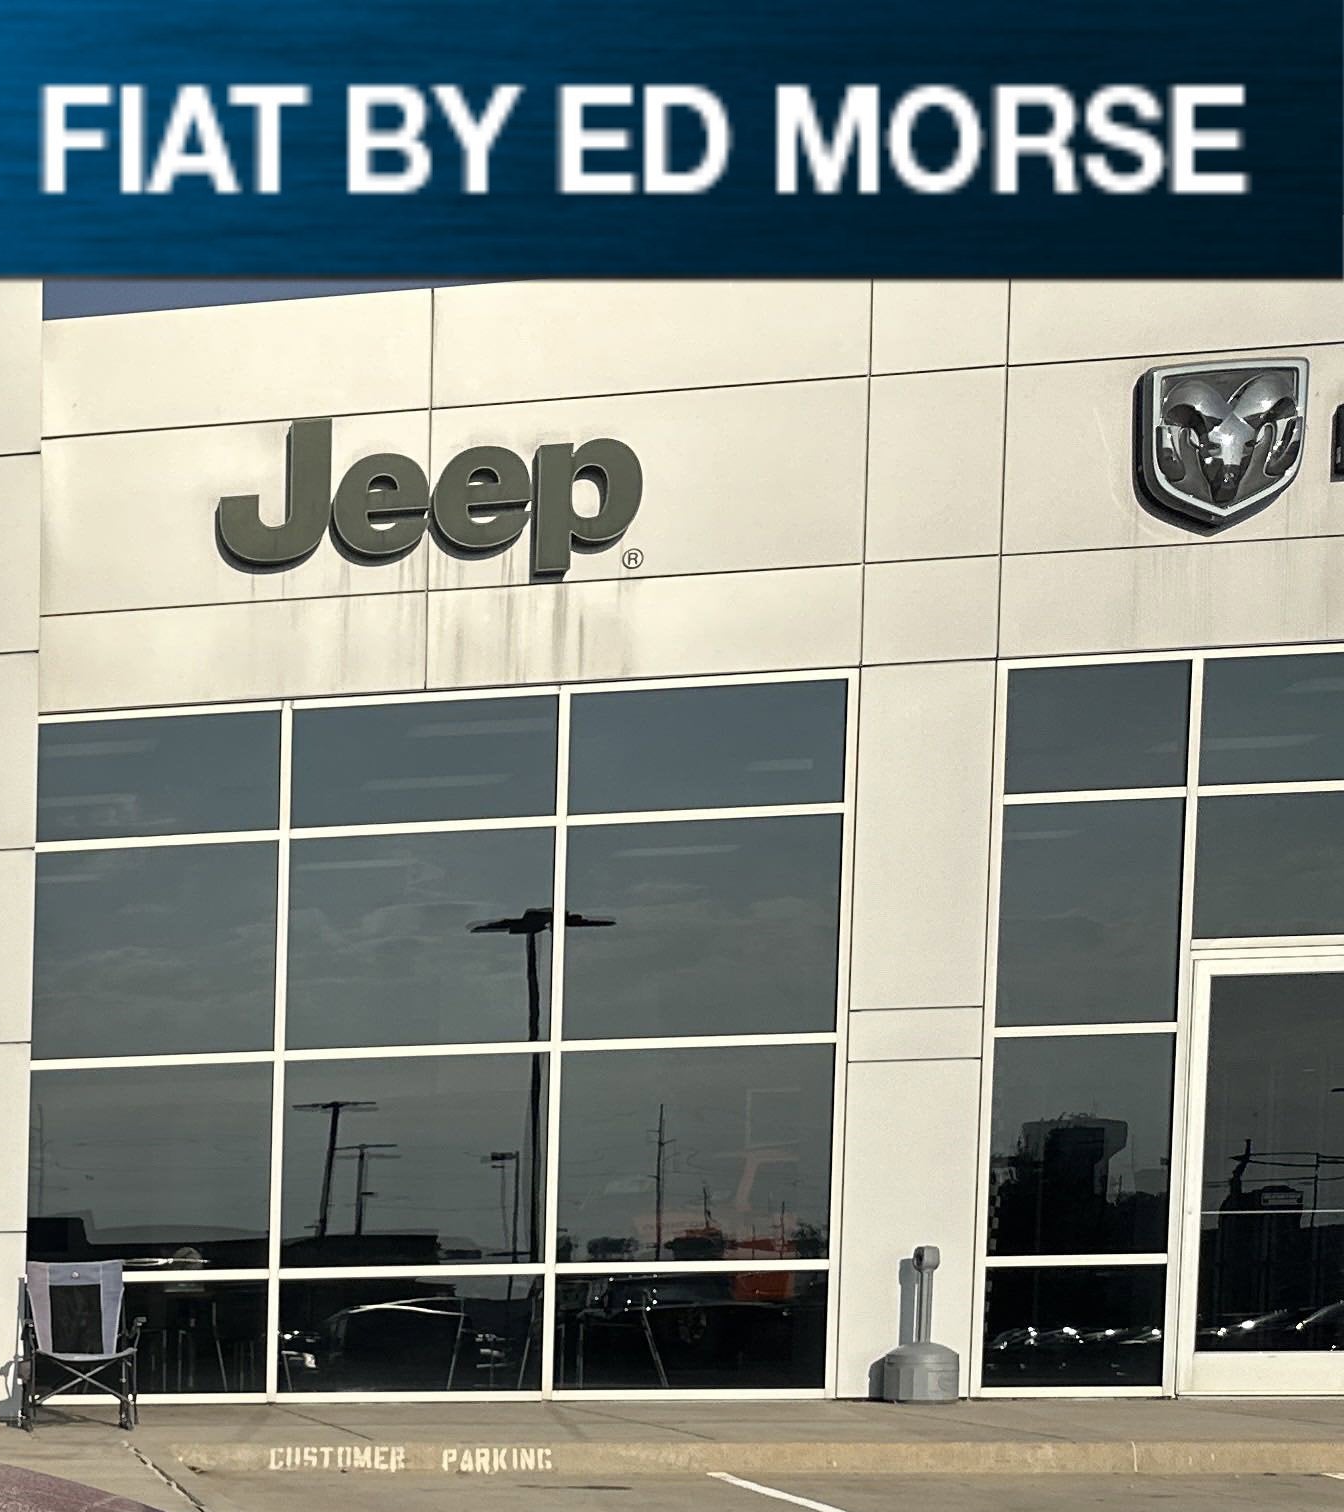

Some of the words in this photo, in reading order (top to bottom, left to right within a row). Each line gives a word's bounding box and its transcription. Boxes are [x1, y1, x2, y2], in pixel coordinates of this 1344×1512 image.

[216, 418, 643, 580] Jeep
[268, 1446, 405, 1472] CUSTOMER
[441, 1447, 552, 1473] PARKING
